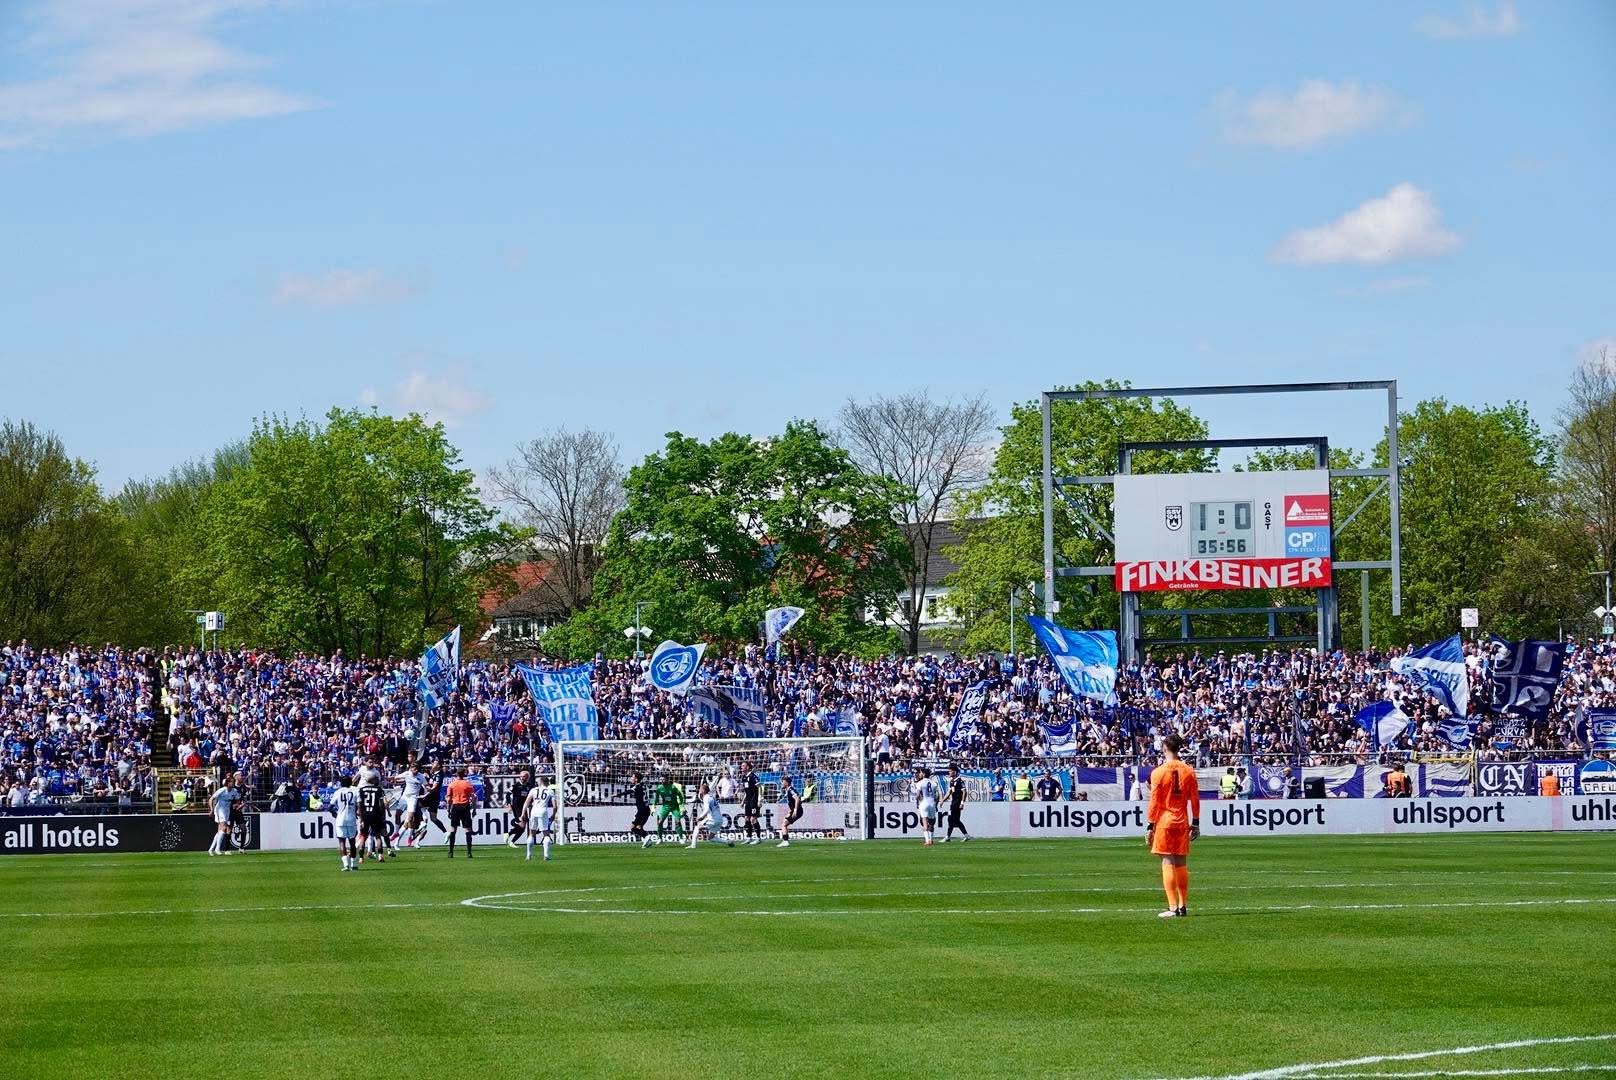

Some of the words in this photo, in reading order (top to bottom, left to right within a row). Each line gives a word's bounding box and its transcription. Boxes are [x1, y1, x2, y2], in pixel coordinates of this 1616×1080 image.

[1263, 502, 1271, 530] GAST
[1197, 539, 1247, 554] 35:56
[1121, 557, 1324, 591] FINKBEINER
[340, 791, 354, 807] 42
[364, 791, 376, 807] 21
[534, 787, 548, 801] 16
[1029, 805, 1143, 832] uhlsport
[1212, 803, 1325, 831] uhlsport
[1393, 801, 1505, 828] uhlsport
[4, 824, 33, 848] all
[42, 823, 119, 848] hotels
[569, 832, 637, 843] Eisenbach
